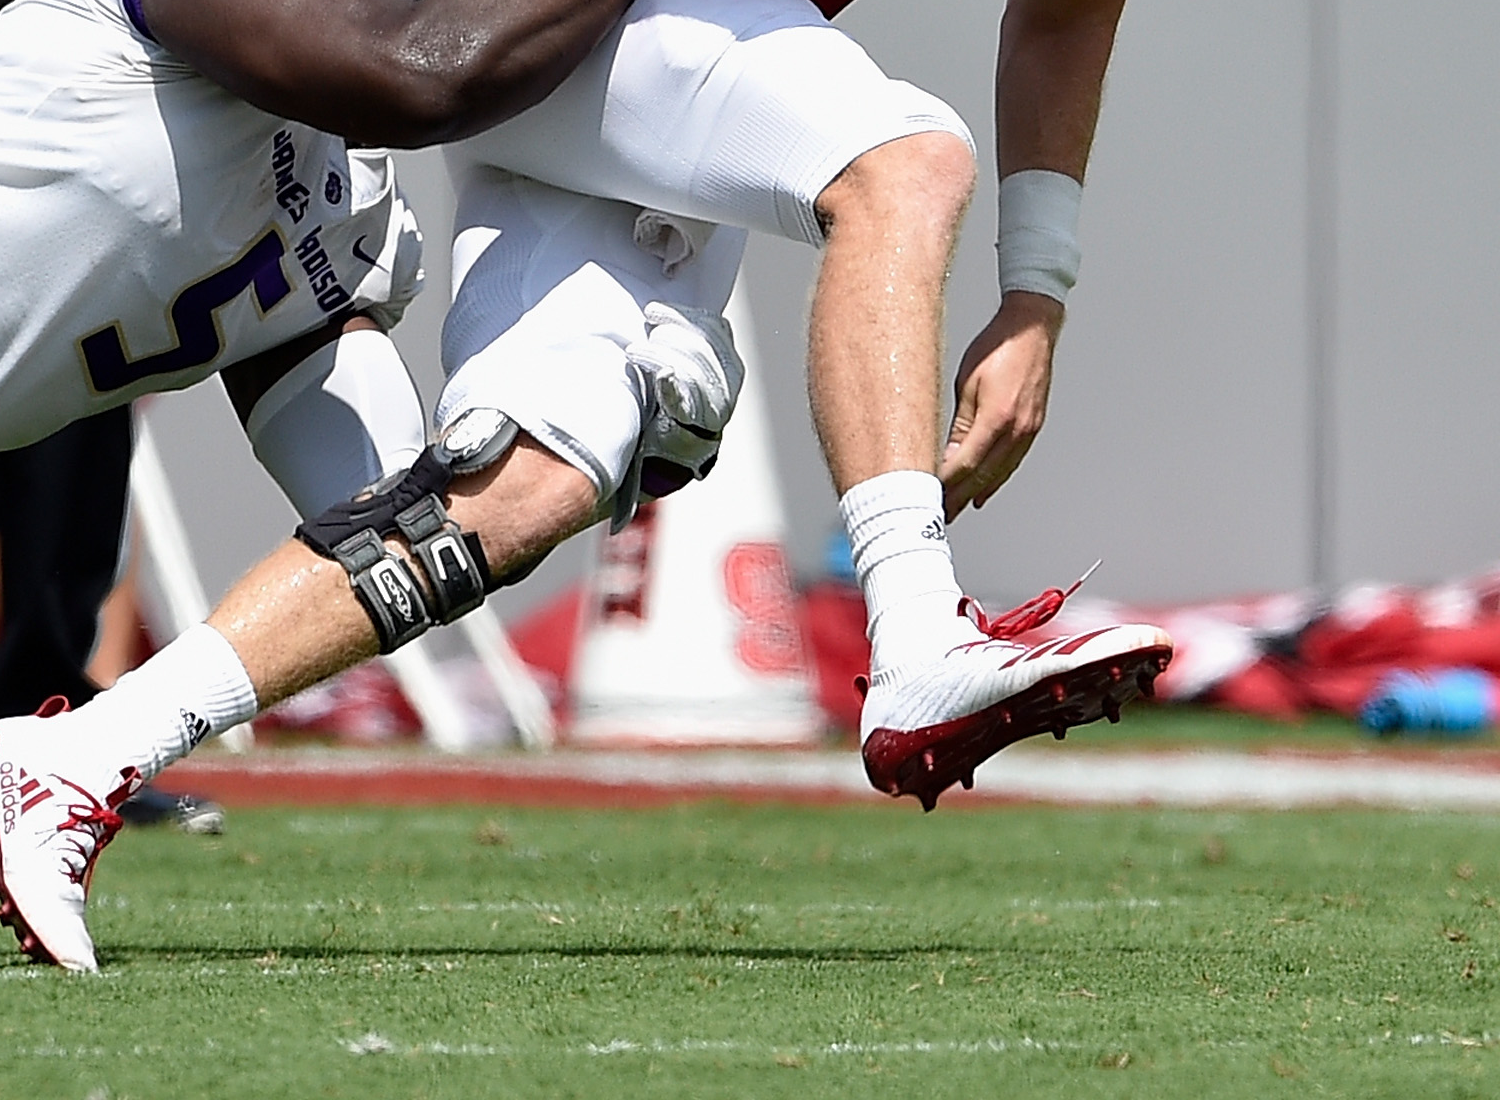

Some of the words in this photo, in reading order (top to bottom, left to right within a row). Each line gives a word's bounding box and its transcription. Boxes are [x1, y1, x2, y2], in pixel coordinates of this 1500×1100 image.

[271, 129, 311, 225] JAMES
[73, 220, 298, 398] 5
[0, 761, 20, 835] adidas
